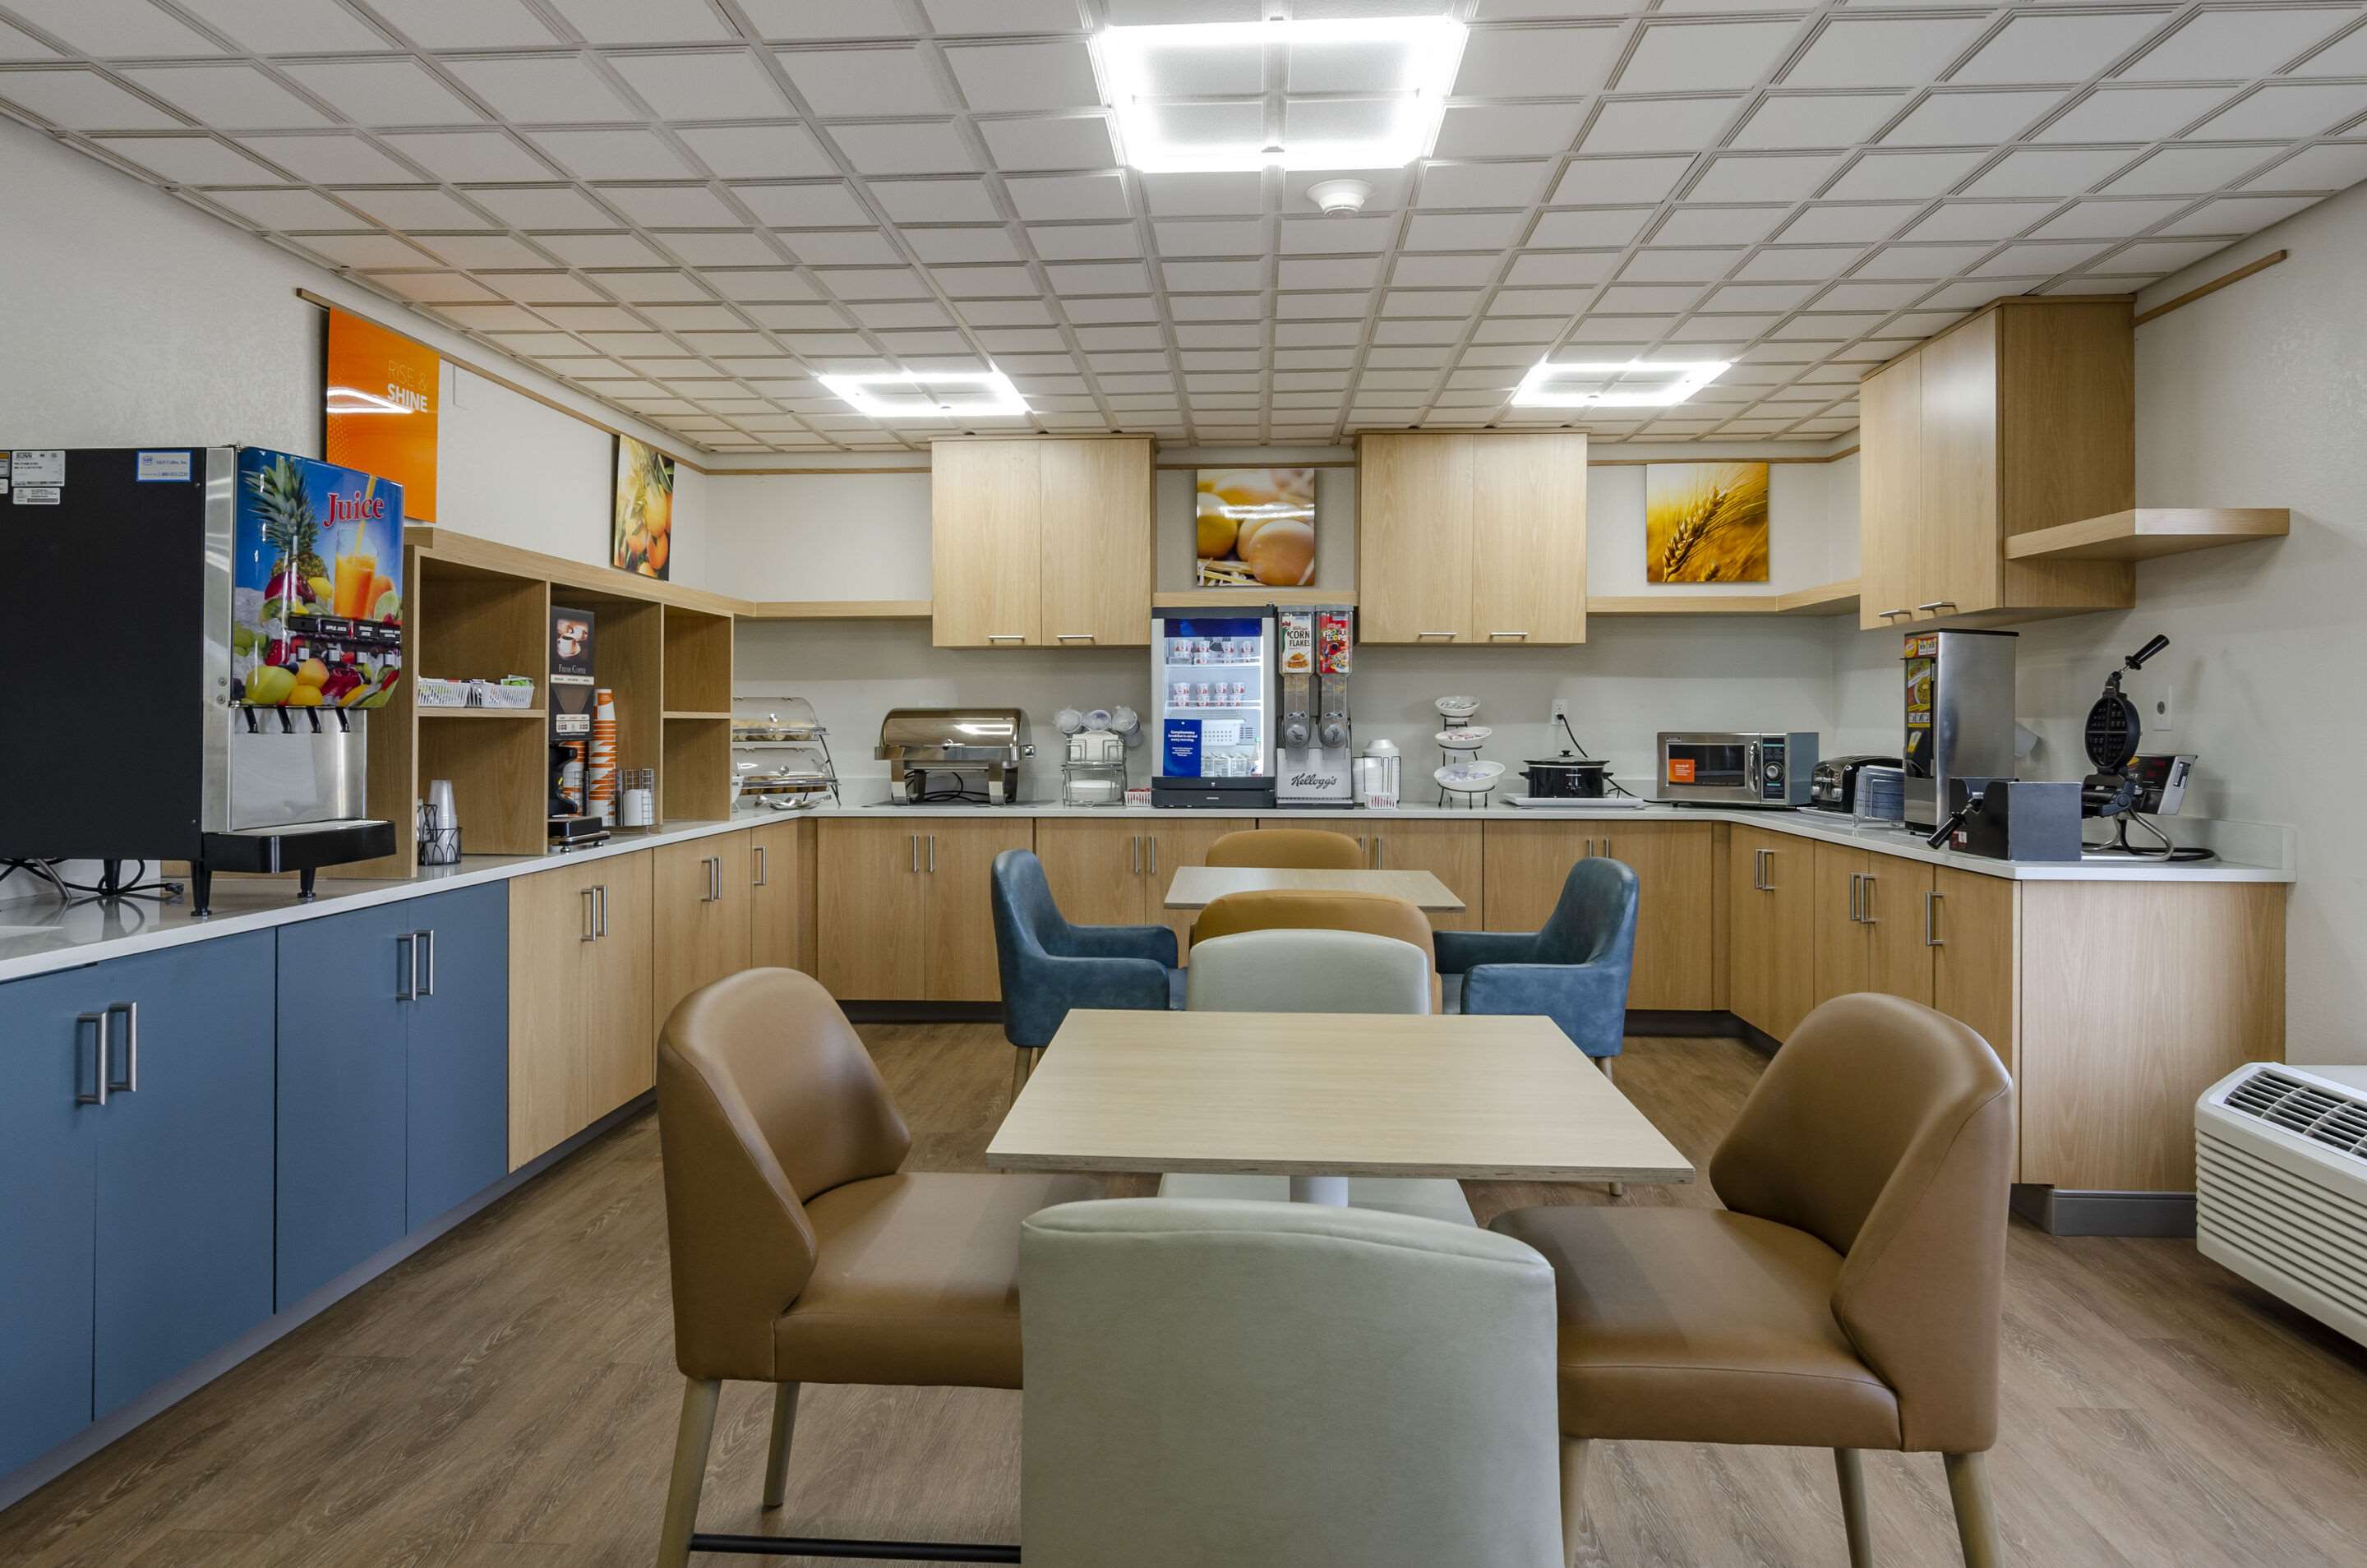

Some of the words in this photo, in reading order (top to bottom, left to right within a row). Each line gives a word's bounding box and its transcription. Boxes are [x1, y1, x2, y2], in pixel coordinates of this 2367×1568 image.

[388, 360, 414, 388] RISE
[420, 372, 428, 392] &
[387, 382, 428, 413] SHINE
[322, 490, 385, 528] Juice
[1289, 630, 1310, 639] CORN
[1290, 772, 1338, 790] Kellogg's
